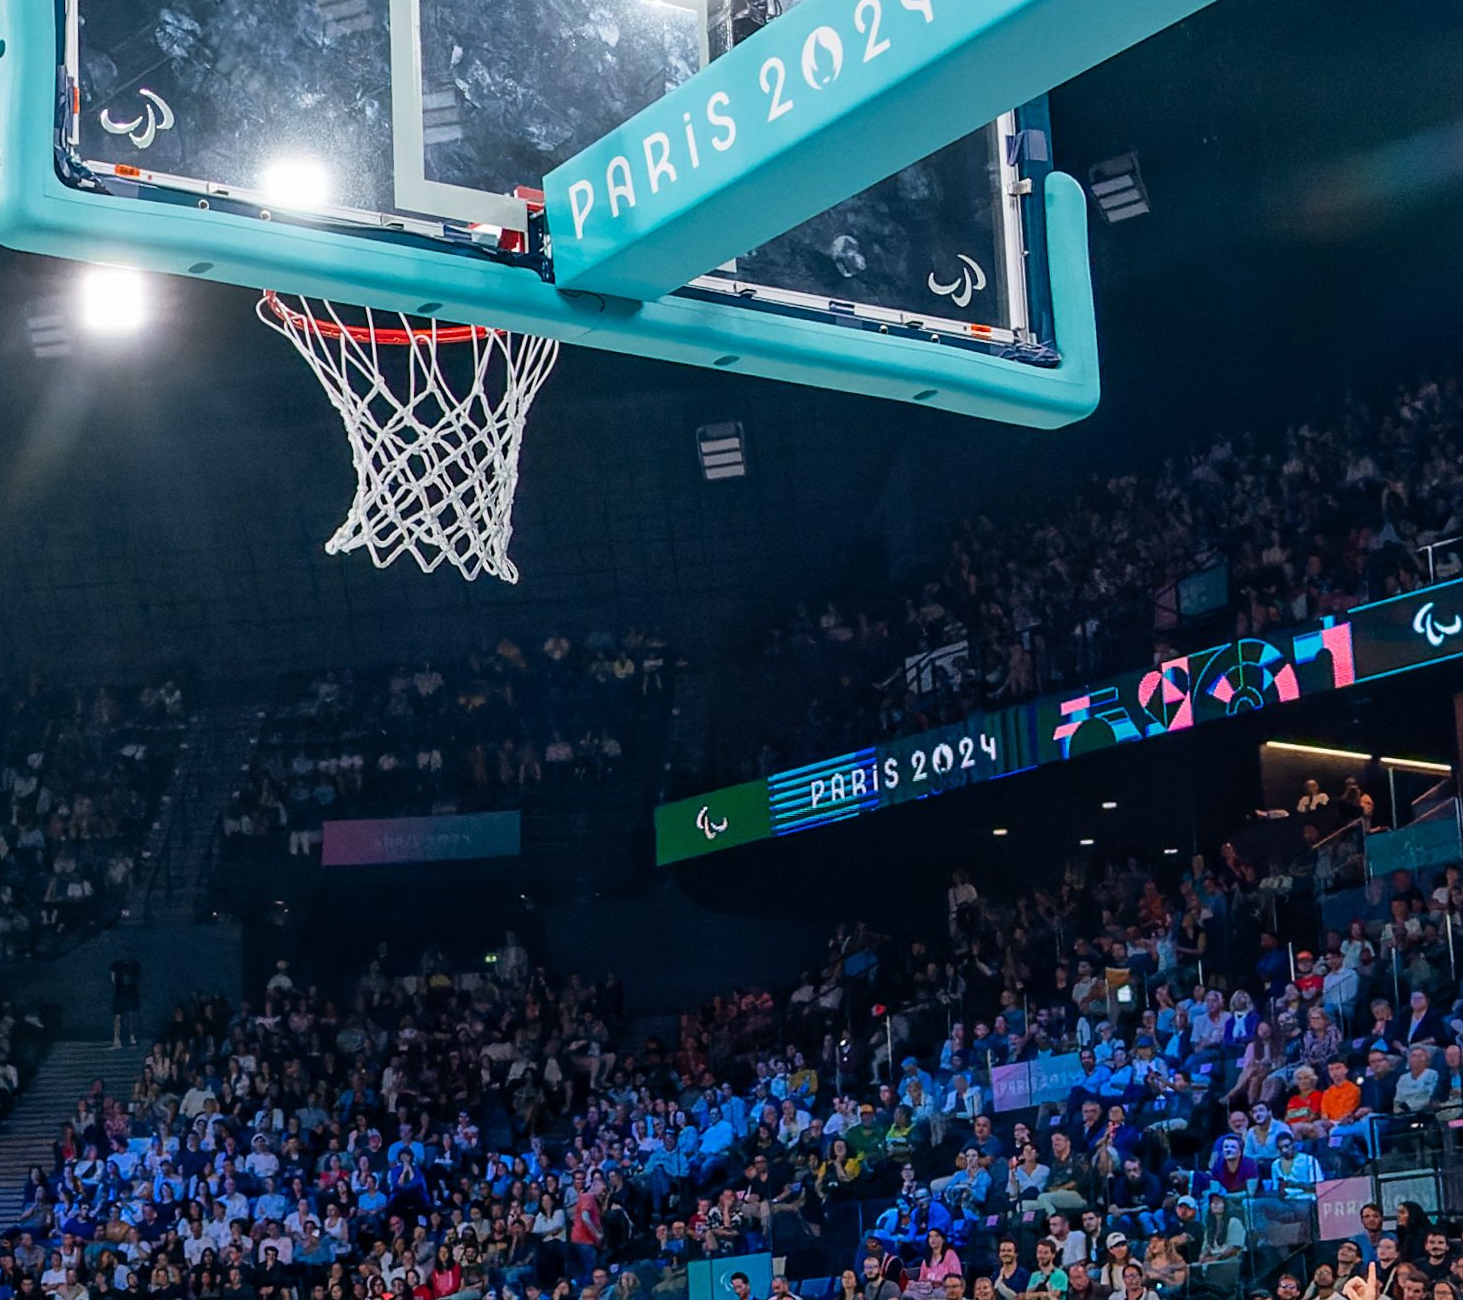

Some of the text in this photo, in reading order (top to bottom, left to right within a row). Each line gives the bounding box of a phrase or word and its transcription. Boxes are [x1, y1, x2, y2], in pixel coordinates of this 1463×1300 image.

[568, 90, 737, 241] PARIS
[809, 734, 997, 808] PARIS 2024
